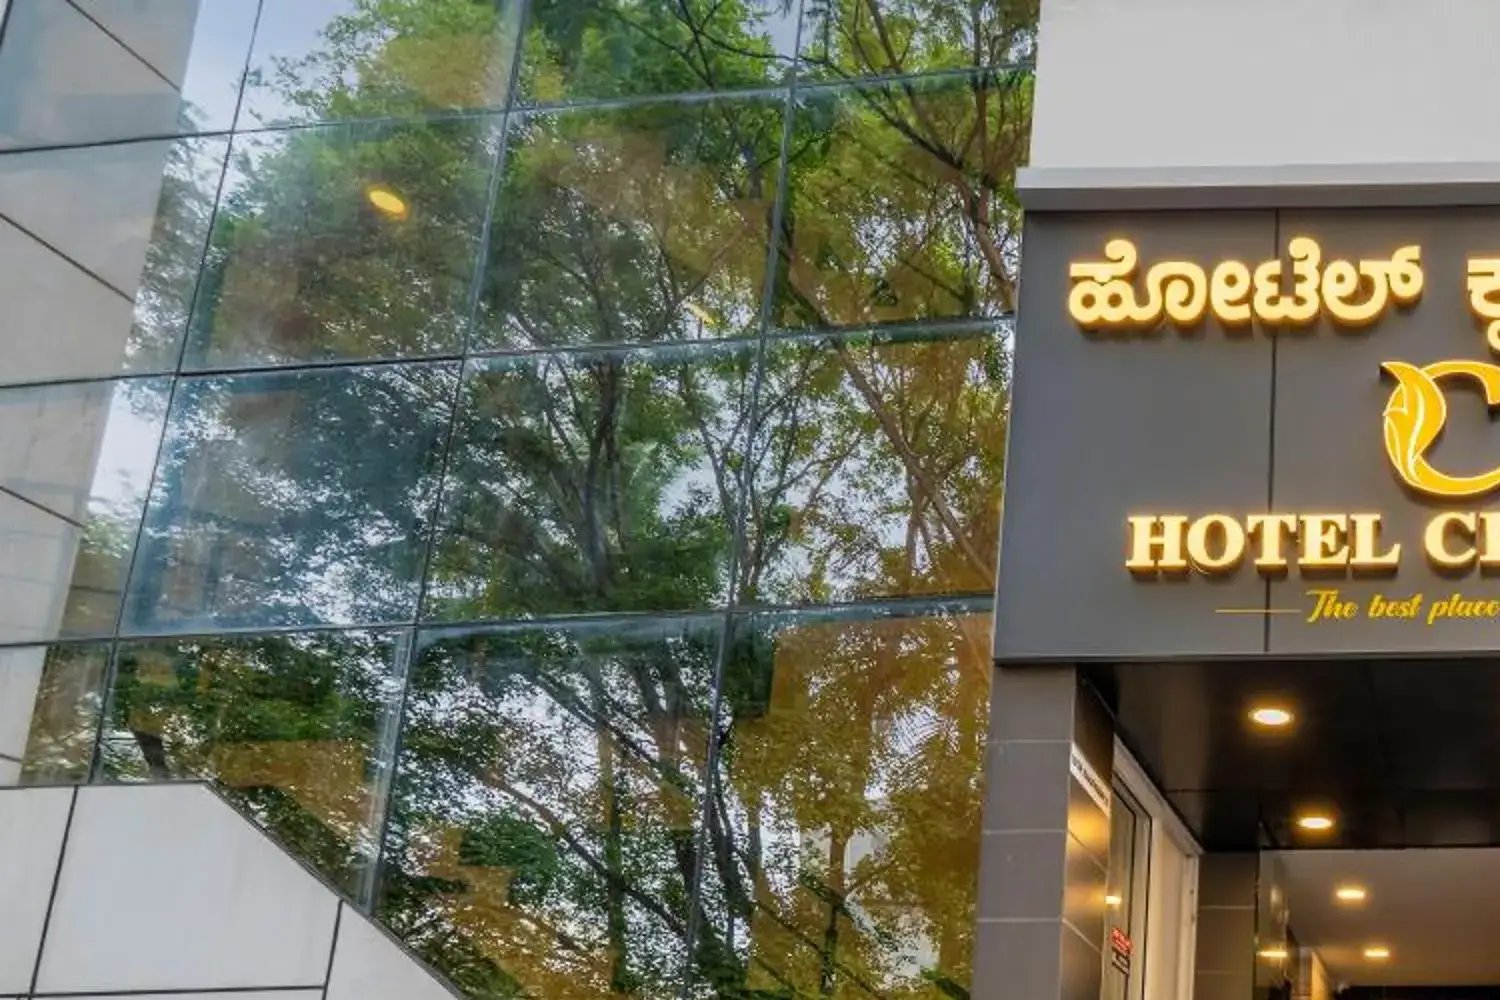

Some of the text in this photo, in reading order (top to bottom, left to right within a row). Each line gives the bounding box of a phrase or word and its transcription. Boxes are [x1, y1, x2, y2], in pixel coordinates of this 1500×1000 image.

[1068, 236, 1425, 328] ಹೋಟೆಲ್
[1125, 511, 1402, 572] HOTEL
[1305, 588, 1358, 623] The
[1367, 593, 1422, 620] best
